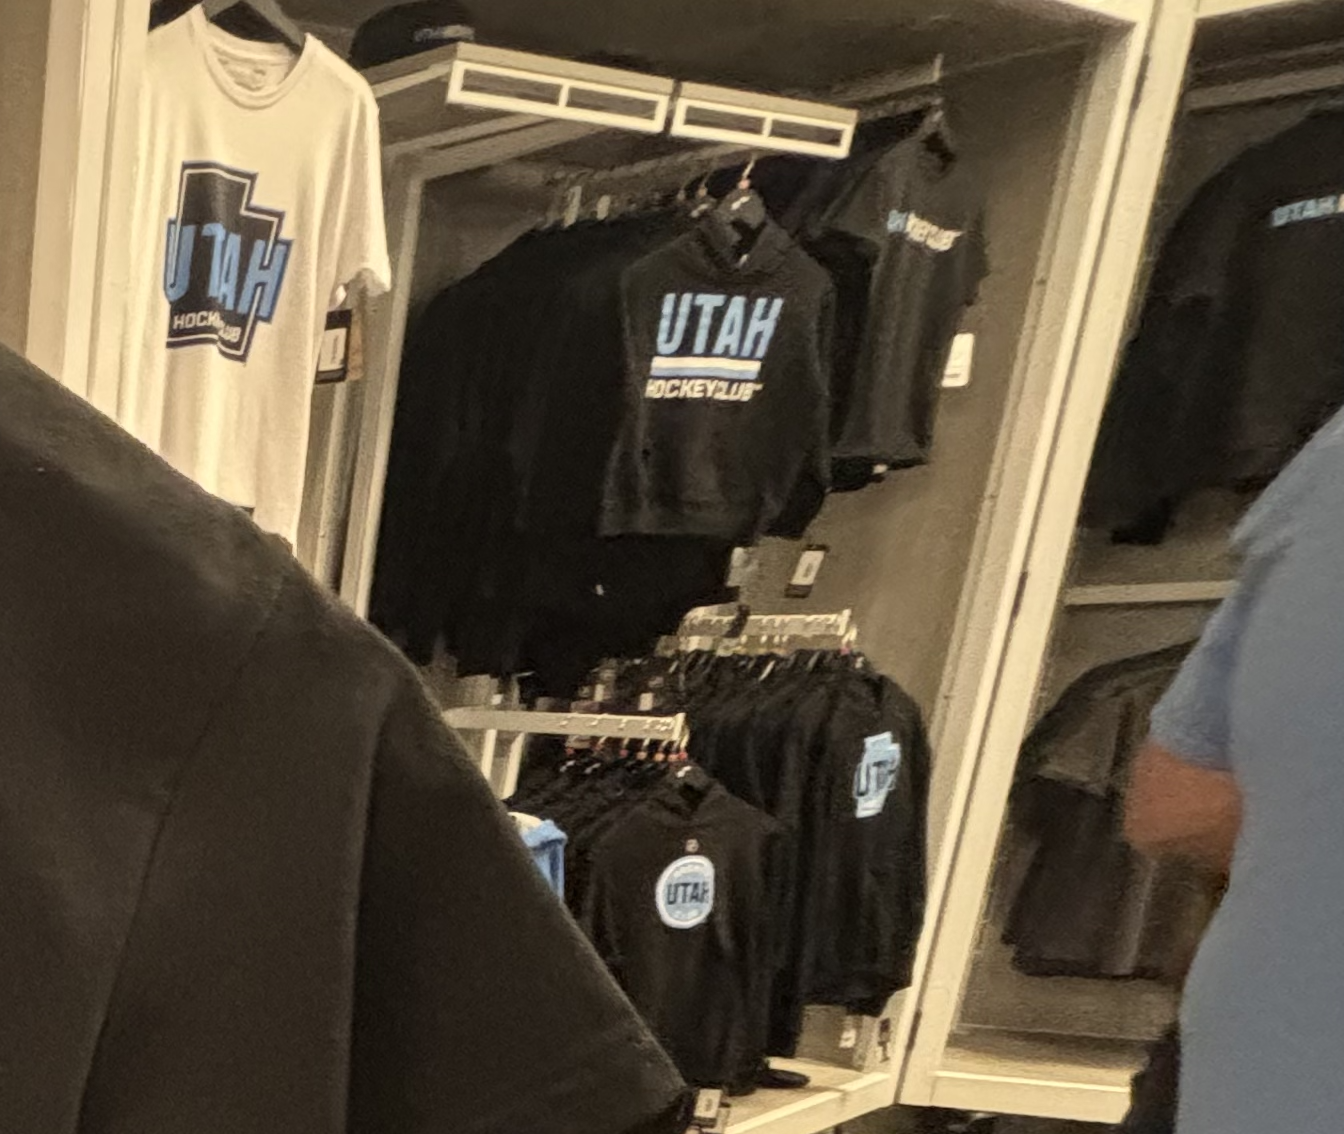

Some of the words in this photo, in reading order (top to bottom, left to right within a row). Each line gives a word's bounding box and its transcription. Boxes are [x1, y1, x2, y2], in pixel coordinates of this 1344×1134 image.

[166, 222, 289, 318] UTAH
[173, 309, 227, 331] HOCK
[656, 292, 785, 359] UTAH
[645, 378, 719, 399] HOCKEY
